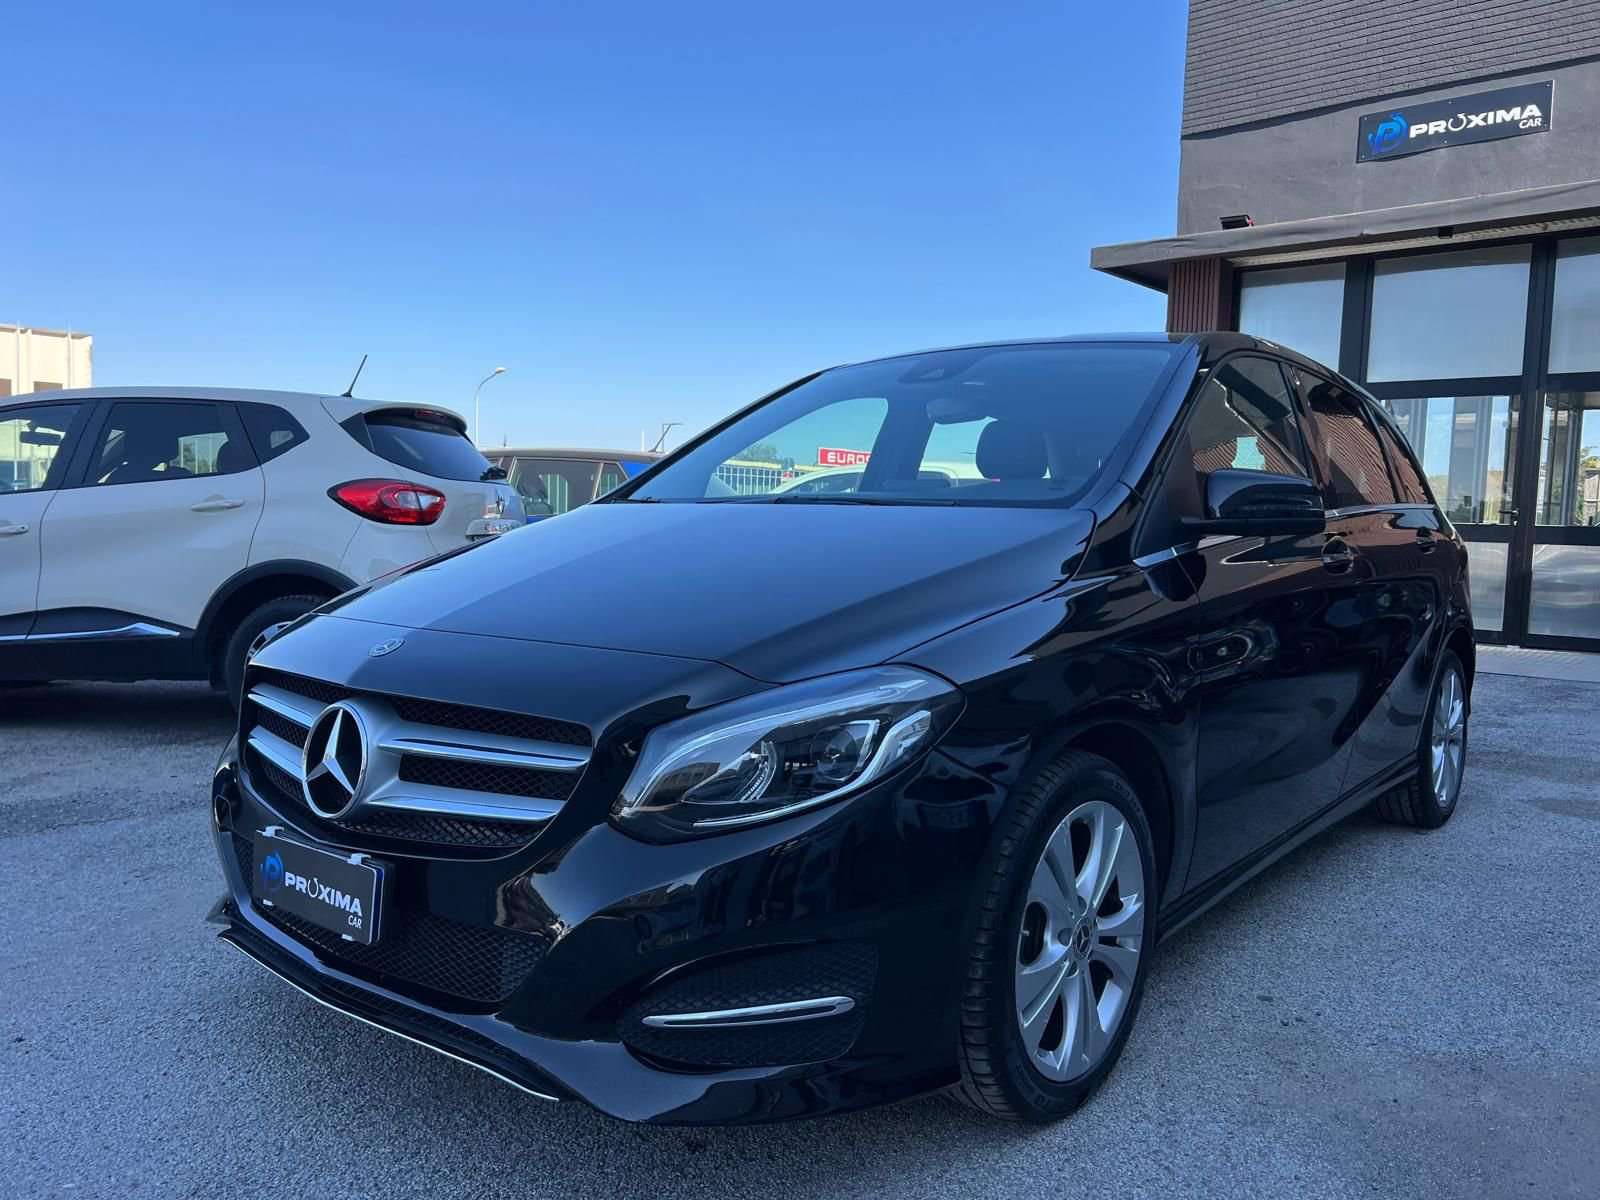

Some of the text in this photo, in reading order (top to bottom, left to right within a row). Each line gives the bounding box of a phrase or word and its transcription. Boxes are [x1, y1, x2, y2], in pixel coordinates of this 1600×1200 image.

[1409, 104, 1542, 138] PROXIMA
[1519, 117, 1542, 129] CAR
[284, 871, 363, 917] PROXIMA
[347, 915, 362, 928] CAR
